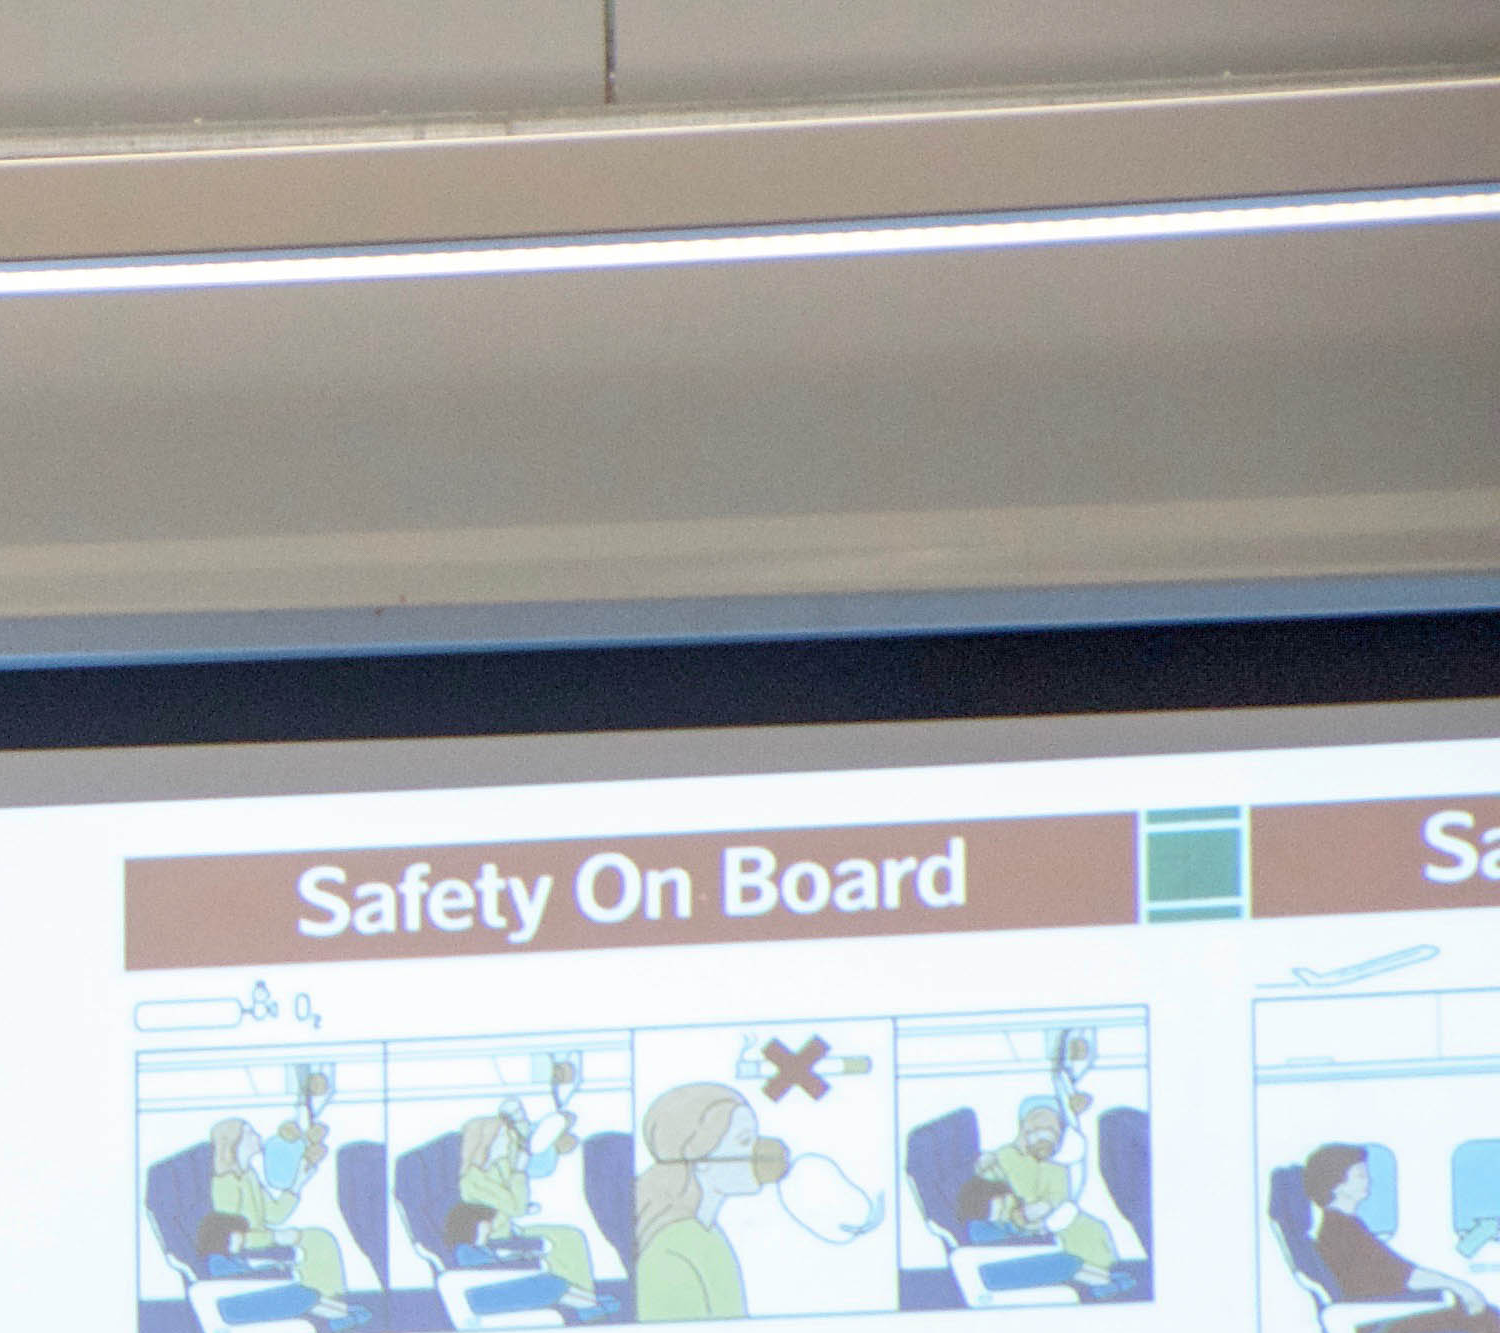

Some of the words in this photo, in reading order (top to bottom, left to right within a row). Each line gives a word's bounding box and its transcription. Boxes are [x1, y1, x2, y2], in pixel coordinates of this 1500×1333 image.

[298, 862, 553, 943] Safety
[575, 851, 693, 924] On
[723, 836, 967, 917] Board
